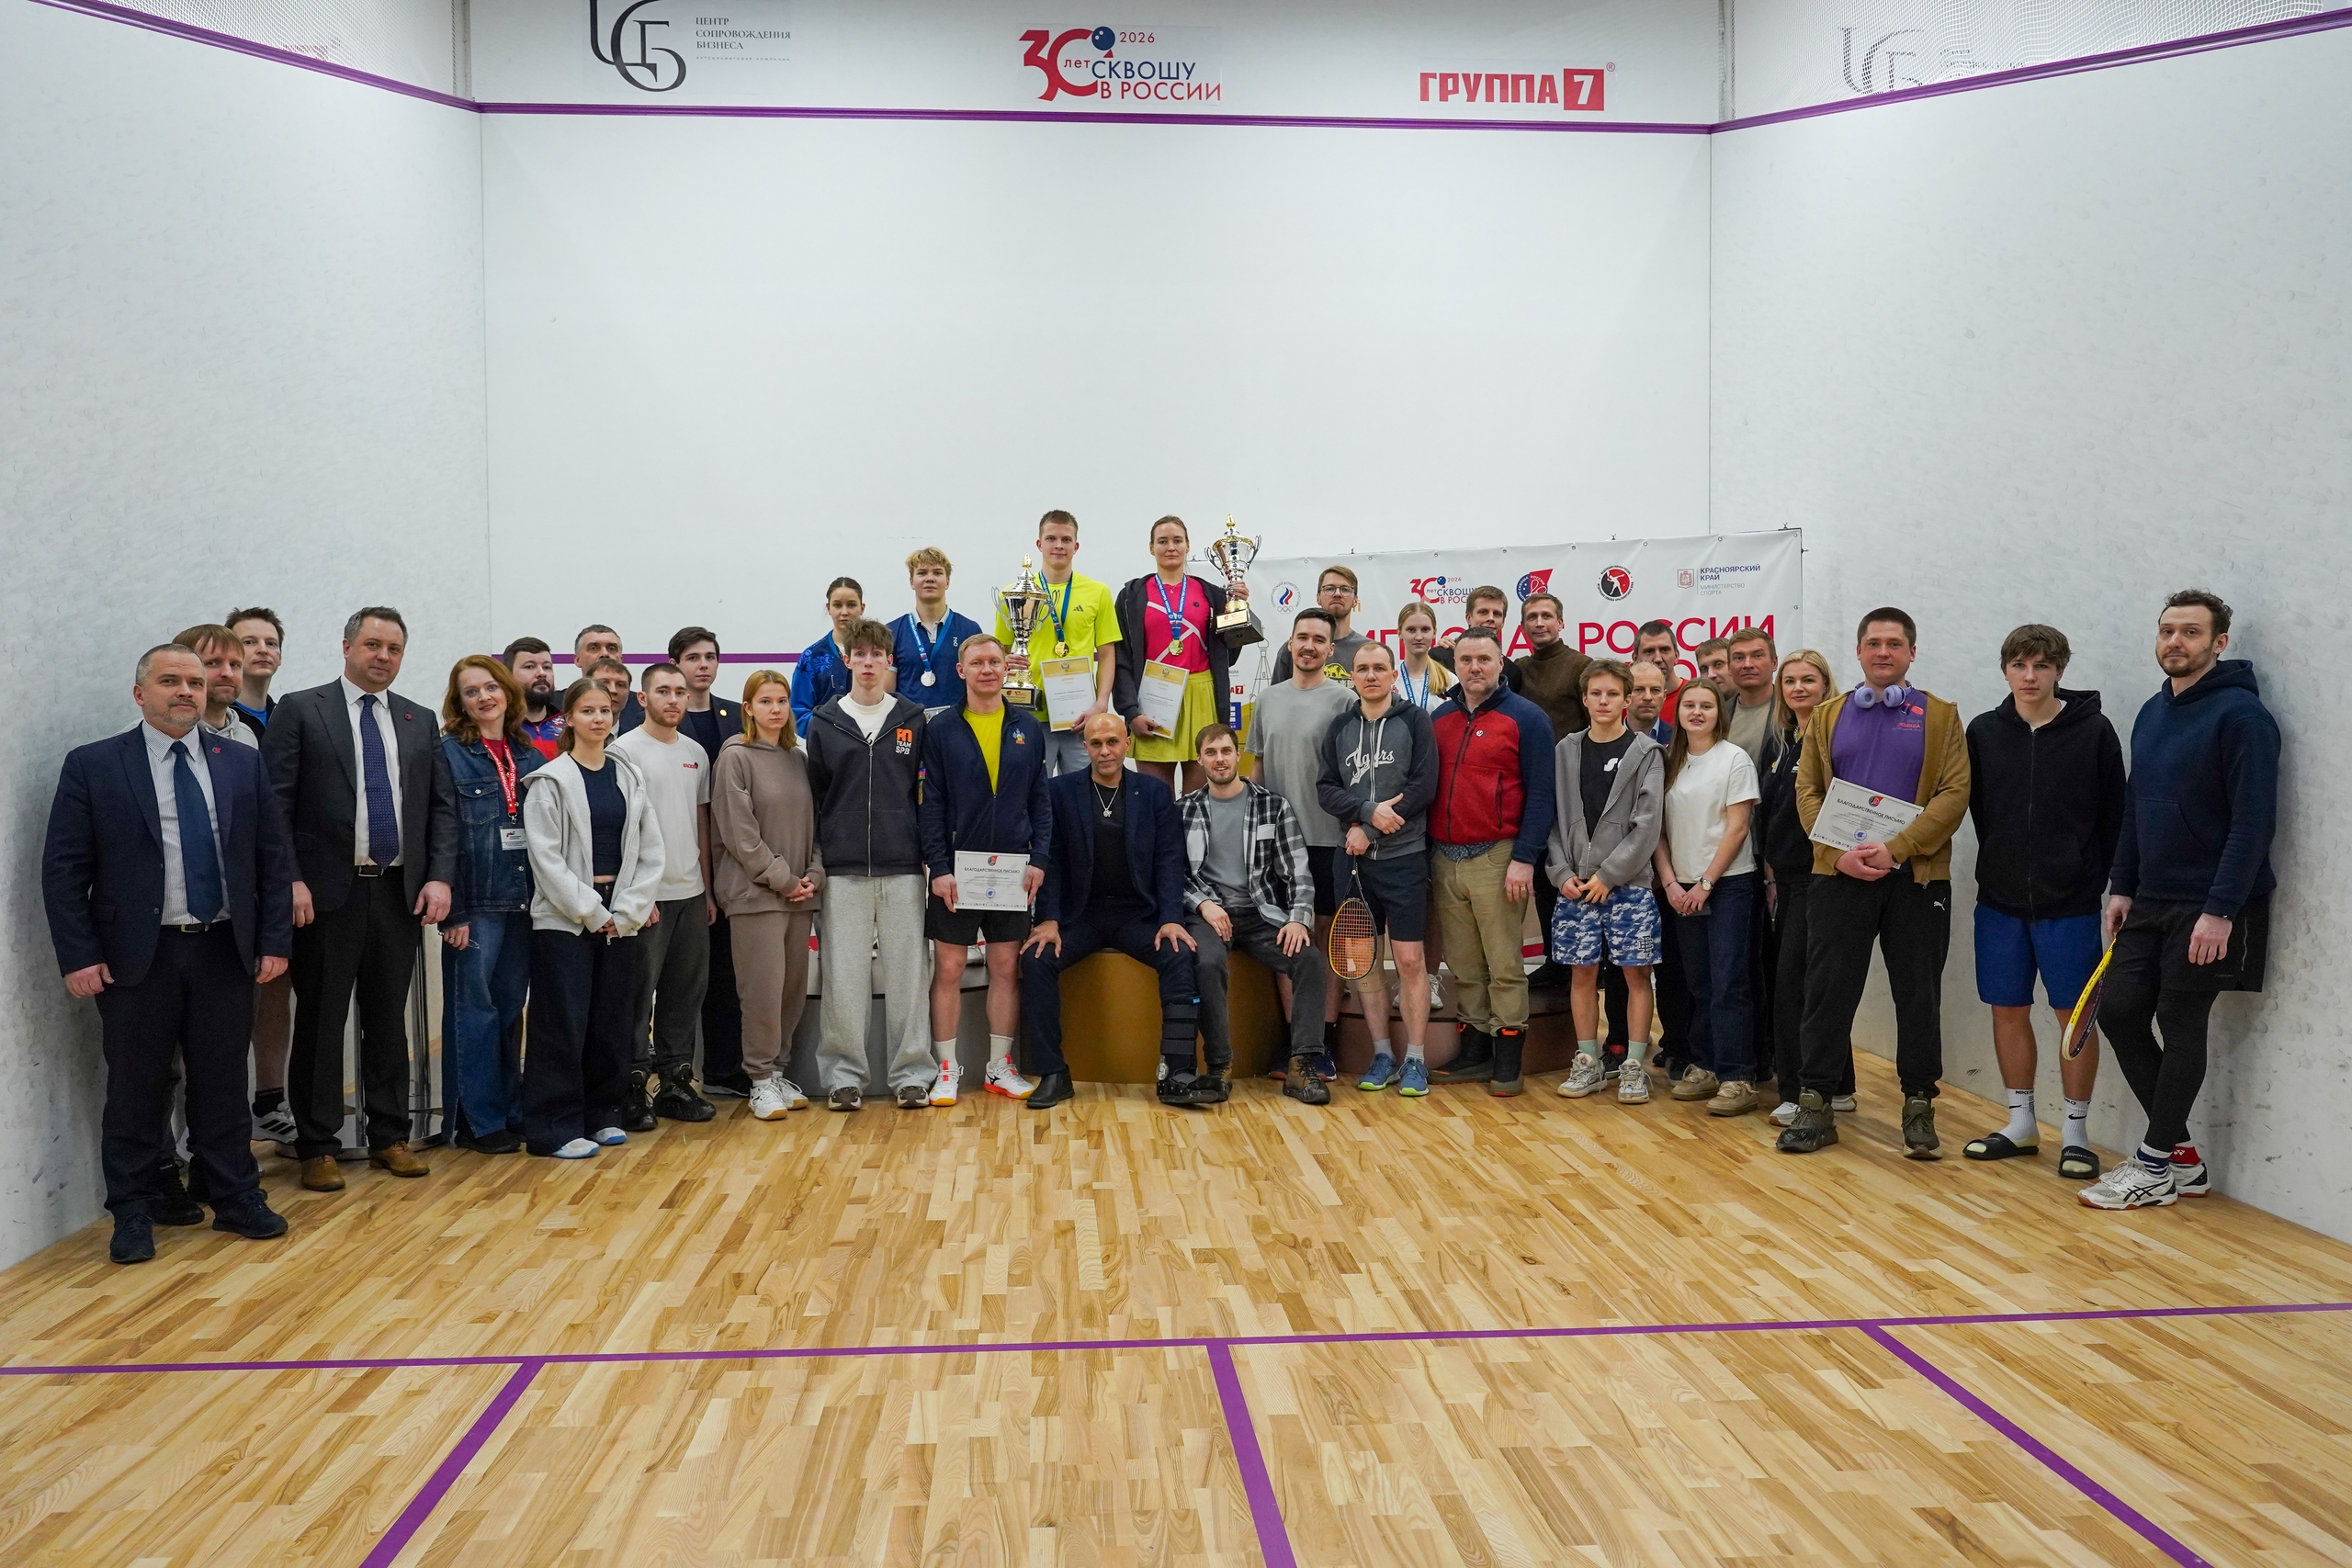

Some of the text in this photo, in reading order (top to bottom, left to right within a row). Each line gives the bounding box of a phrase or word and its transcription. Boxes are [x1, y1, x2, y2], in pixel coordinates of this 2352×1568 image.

[695, 17, 729, 28] ЦЕНТР
[695, 28, 791, 39] СОПРОВОЖДЕНИЯ
[1119, 31, 1155, 43] 2026
[696, 40, 743, 50] БИЗНЕСА
[1063, 59, 1196, 80] лет СКВОШУ
[1101, 81, 1221, 101] В РОССИИ
[1419, 72, 1559, 104] ГРУППА
[1700, 563, 1761, 574] КРАСНОЯРСКИЙ
[1700, 573, 1720, 581] КРАЙ
[1437, 588, 1475, 597] СКВОШ
[1578, 615, 1774, 655] РОСИИ
[896, 739, 911, 748] TEAM
[895, 745, 910, 755] SPB
[1838, 798, 1884, 818] БЛАГОДАРСТВЕННОЕ
[1884, 814, 1905, 825] ПИСЬМО
